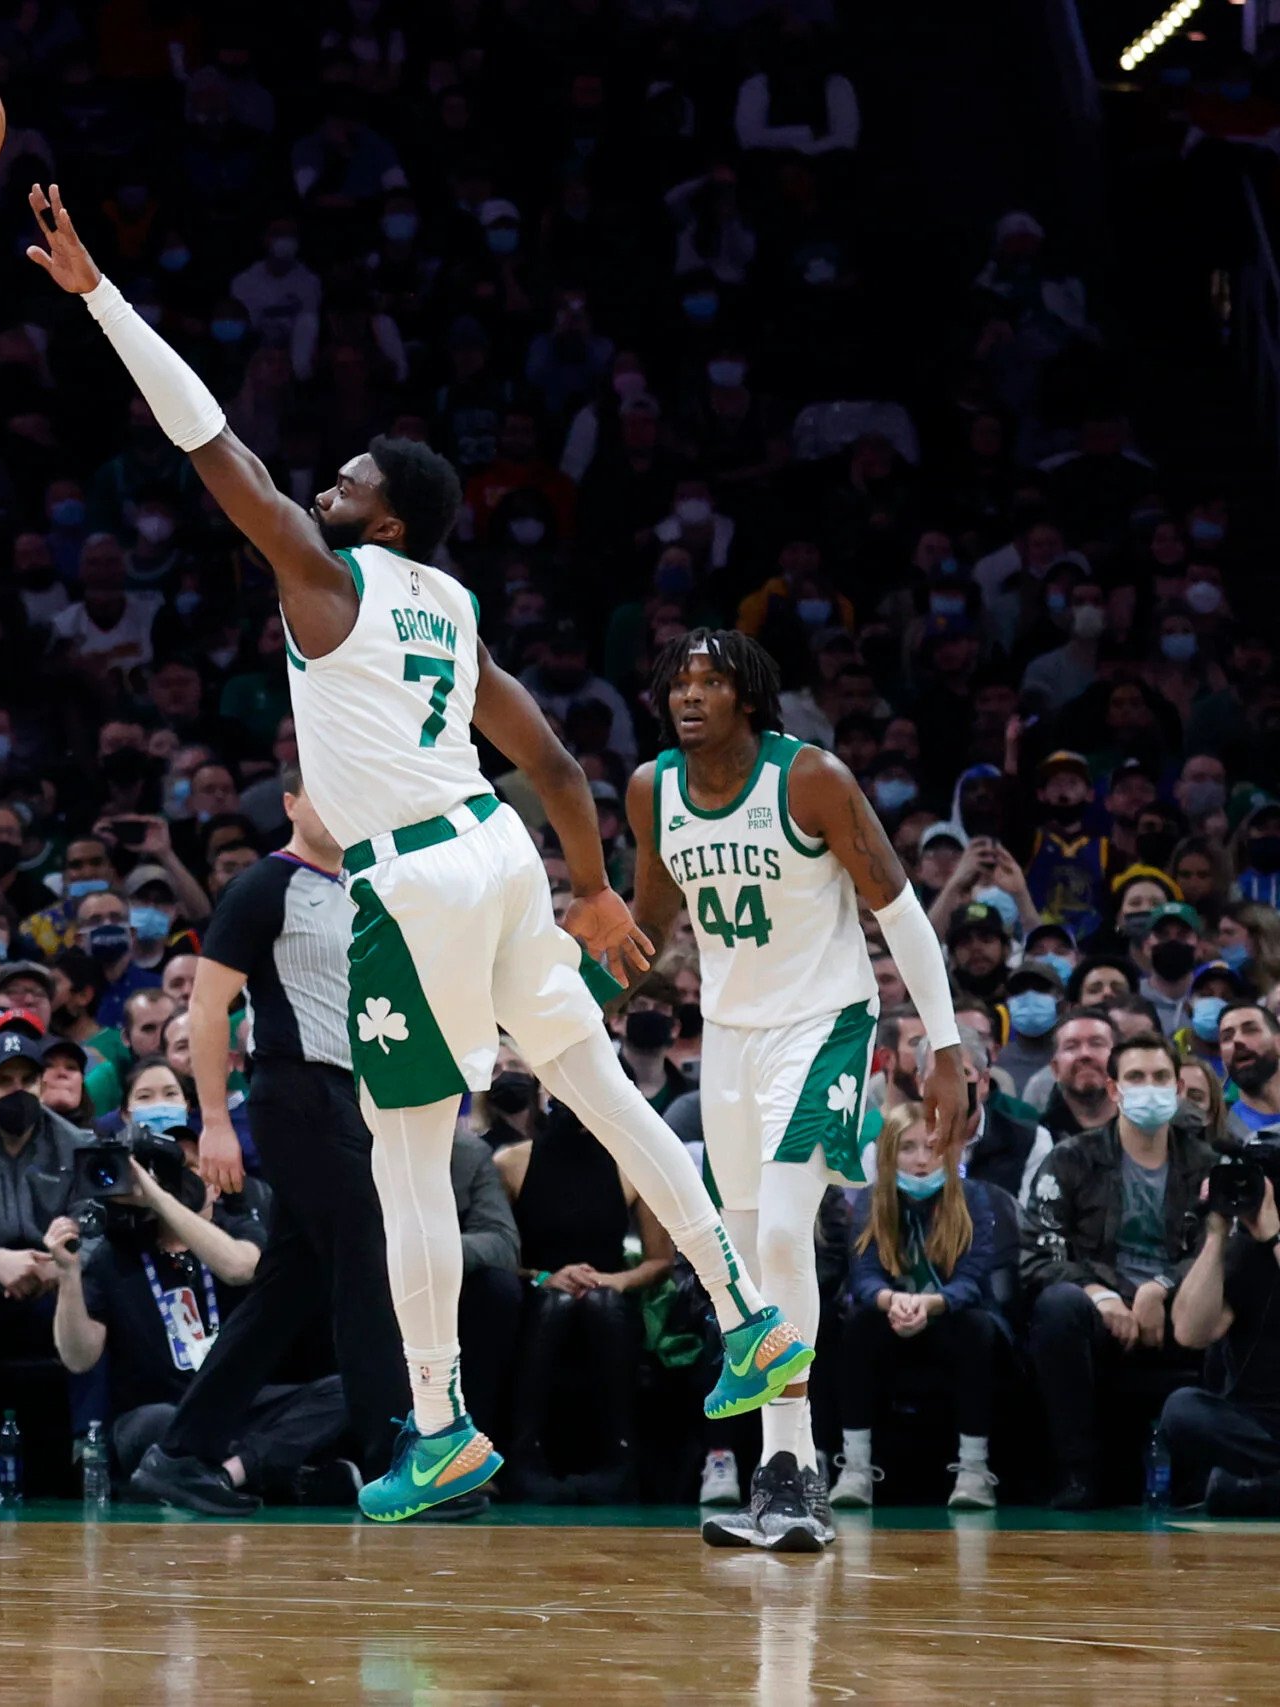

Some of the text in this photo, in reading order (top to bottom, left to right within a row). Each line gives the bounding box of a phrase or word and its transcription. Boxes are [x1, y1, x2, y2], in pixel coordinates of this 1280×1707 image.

[391, 608, 458, 655] BROWN
[403, 653, 455, 748] 7
[747, 807, 773, 819] VISTA
[748, 818, 773, 830] PRINT
[670, 842, 781, 885] CELTICS
[697, 884, 773, 948] 44
